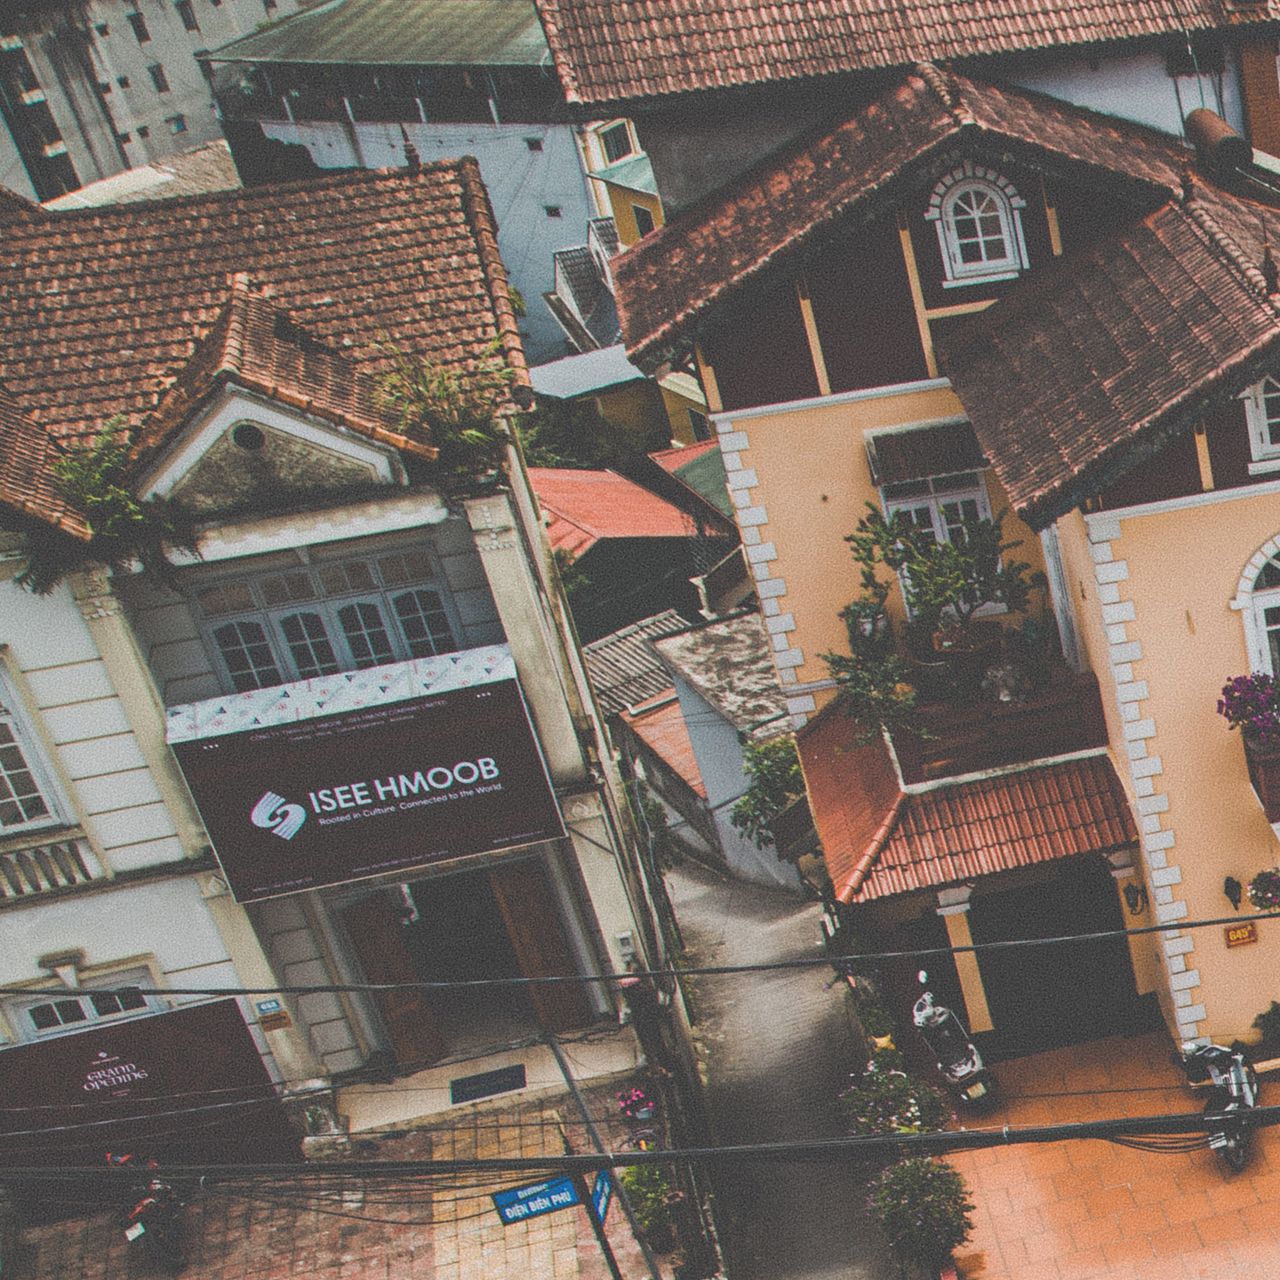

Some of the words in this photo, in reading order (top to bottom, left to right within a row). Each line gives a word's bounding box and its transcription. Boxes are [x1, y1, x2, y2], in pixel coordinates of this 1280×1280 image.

[309, 782, 373, 813] ISEE
[373, 757, 500, 801] HMOOB
[319, 815, 351, 826] Rooted
[352, 812, 361, 820] in
[400, 795, 448, 810] Connected
[449, 791, 459, 799] to
[460, 789, 475, 798] the
[83, 1069, 149, 1091] OPENING
[87, 1063, 136, 1081] GRAND
[505, 1203, 529, 1219] ĐIỆN
[528, 1195, 551, 1212] BIÊN
[550, 1187, 571, 1206] PHỦ
